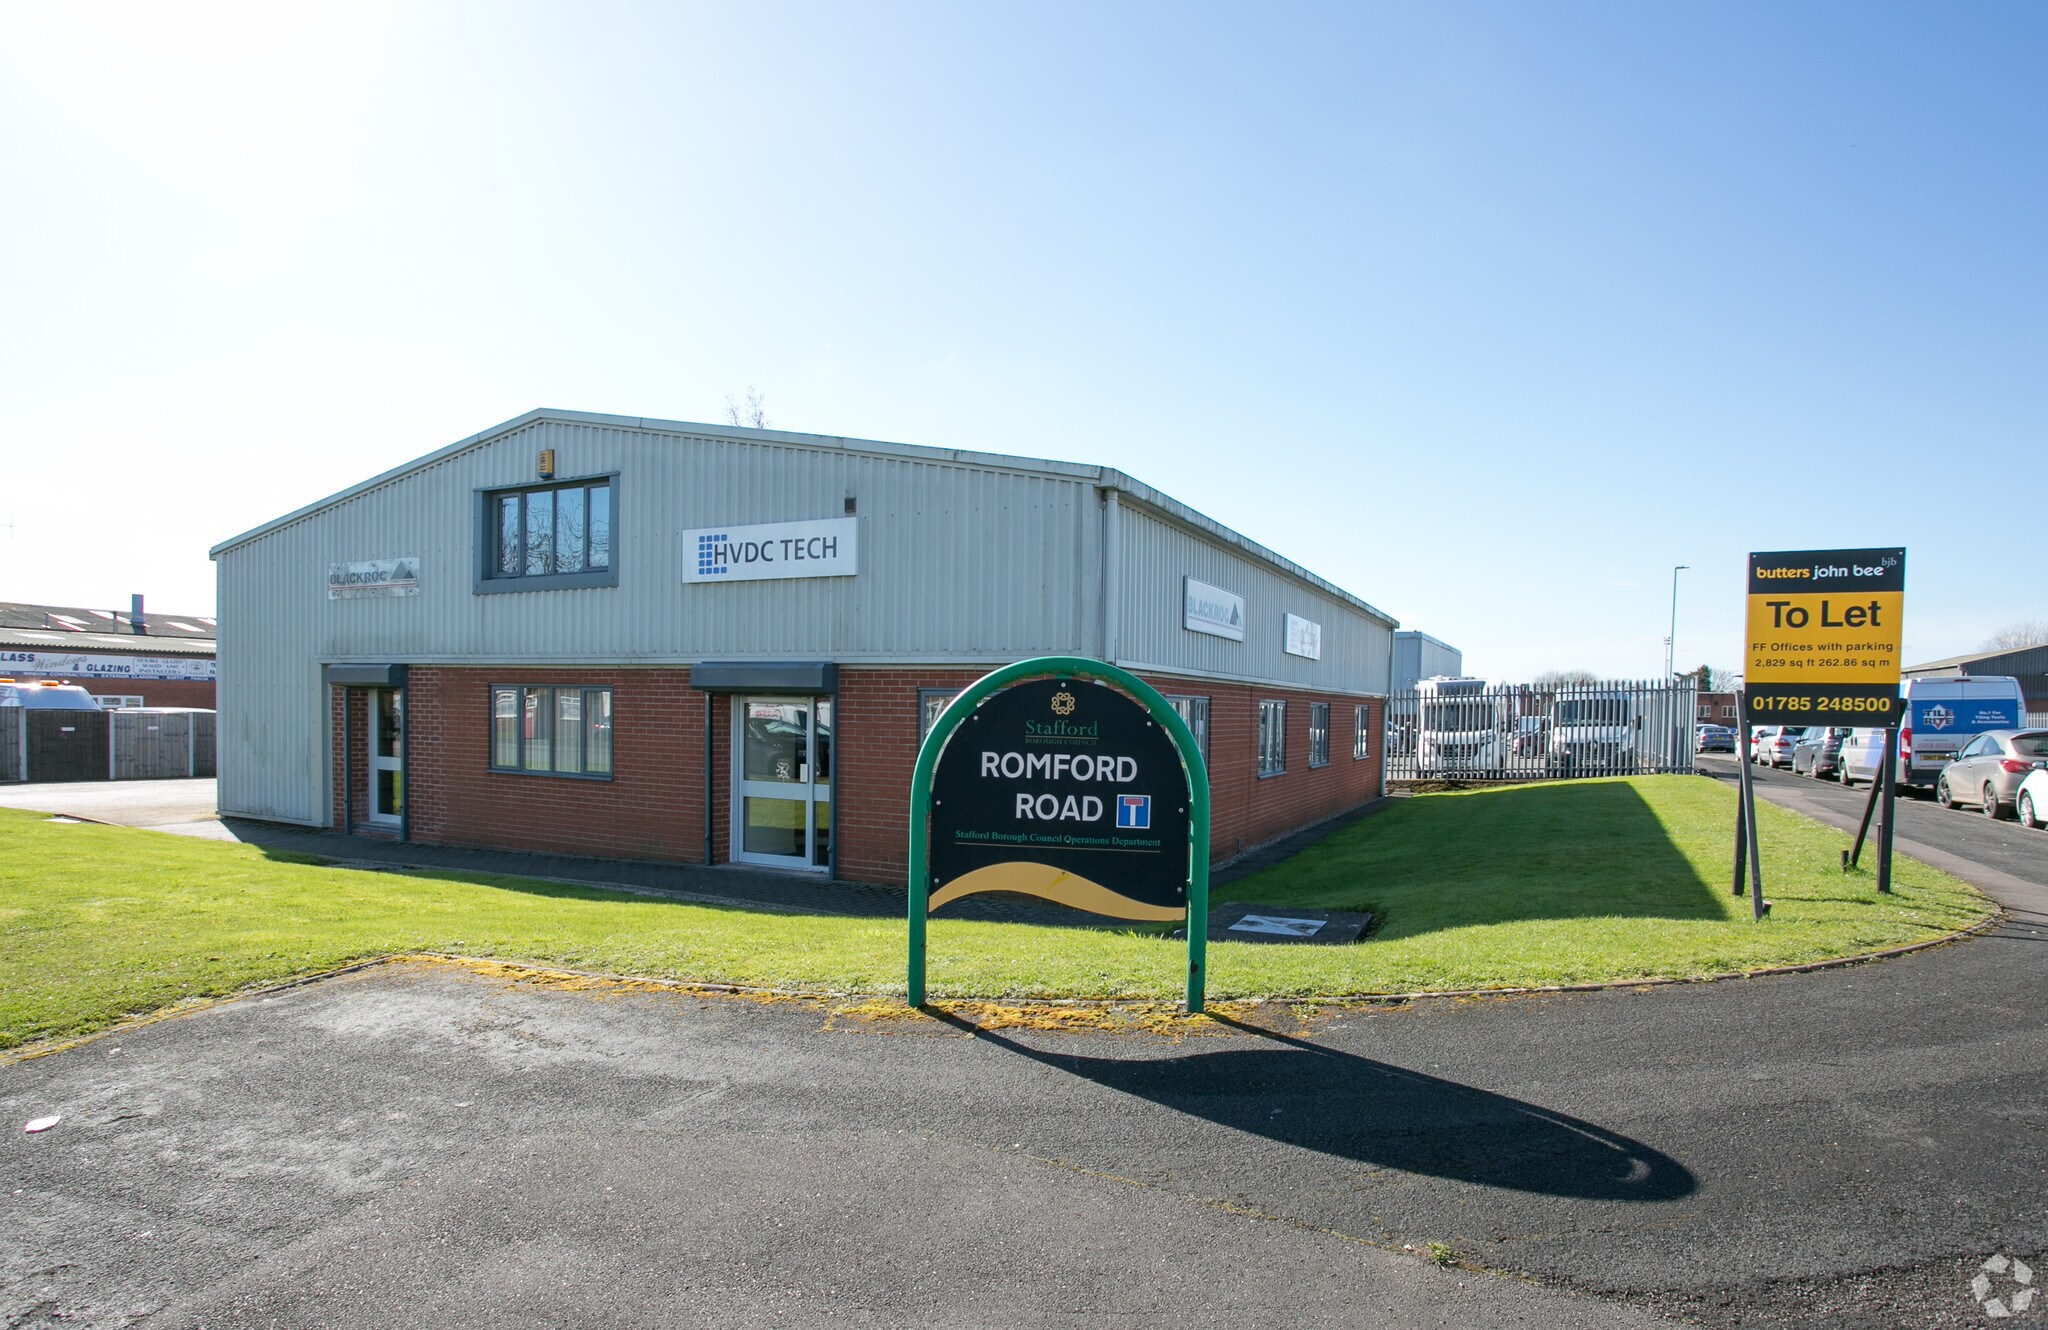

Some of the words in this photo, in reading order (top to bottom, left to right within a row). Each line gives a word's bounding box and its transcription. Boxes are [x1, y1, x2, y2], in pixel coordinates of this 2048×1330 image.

[714, 540, 774, 565] HVDC
[780, 536, 838, 561] TECH
[1881, 557, 1896, 568] bjb
[1756, 566, 1810, 579] butters
[1812, 565, 1848, 581] john
[1853, 564, 1884, 577] bee
[1188, 596, 1229, 623] BLACKROC
[1766, 600, 1809, 629] To
[1820, 600, 1882, 628] Let
[1752, 643, 1767, 652] FF
[1770, 642, 1813, 652] Offices
[1817, 642, 1843, 651] with
[1846, 642, 1894, 653] parking
[72, 663, 79, 671] &
[86, 663, 131, 673] GLAZING
[1755, 659, 1786, 668] 2,829
[1789, 660, 1803, 669] sq
[1806, 658, 1815, 667] ft
[1818, 658, 1858, 667] 262.86
[1861, 660, 1876, 669] sq
[1752, 696, 1811, 711] 01785
[1816, 696, 1891, 712] 248500
[1923, 708, 1954, 717] TILE
[1025, 719, 1098, 736] Stafford
[1923, 717, 1954, 726] RITE
[1064, 738, 1097, 746] COUNCIL
[980, 751, 1138, 783] ROMFORD
[1015, 792, 1103, 822] ROAD
[955, 830, 989, 840] Stafford
[991, 832, 1027, 842] Borough
[1029, 833, 1062, 843] Council
[1064, 835, 1110, 845] Operations
[1112, 837, 1161, 847] Department
